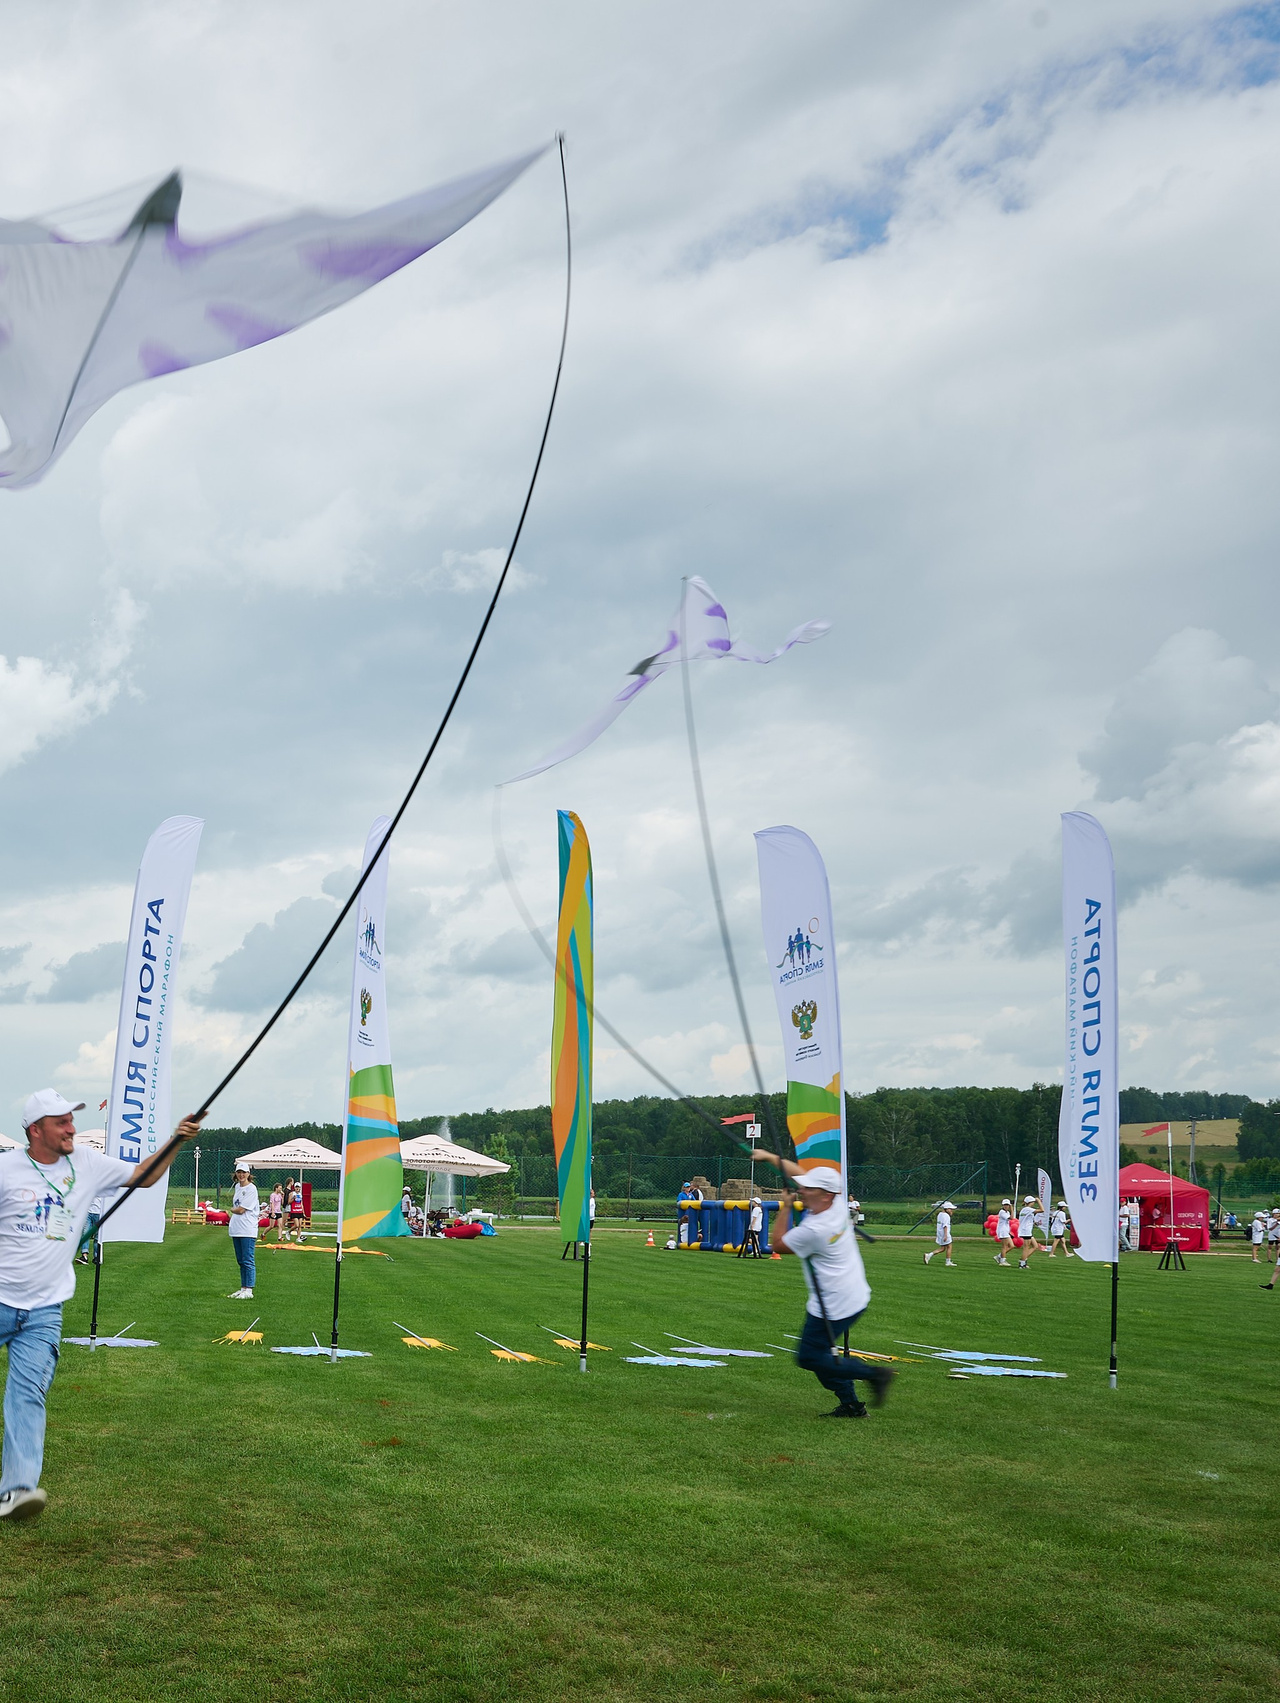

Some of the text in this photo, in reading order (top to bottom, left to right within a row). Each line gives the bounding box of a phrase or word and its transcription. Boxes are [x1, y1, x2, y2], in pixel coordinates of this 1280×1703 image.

[119, 897, 165, 1163] ЕМЛЯ СПОРТА
[148, 934, 174, 1153] СЕРОССИЙСКИЙ МАРАФОН
[749, 1125, 756, 1137] 2
